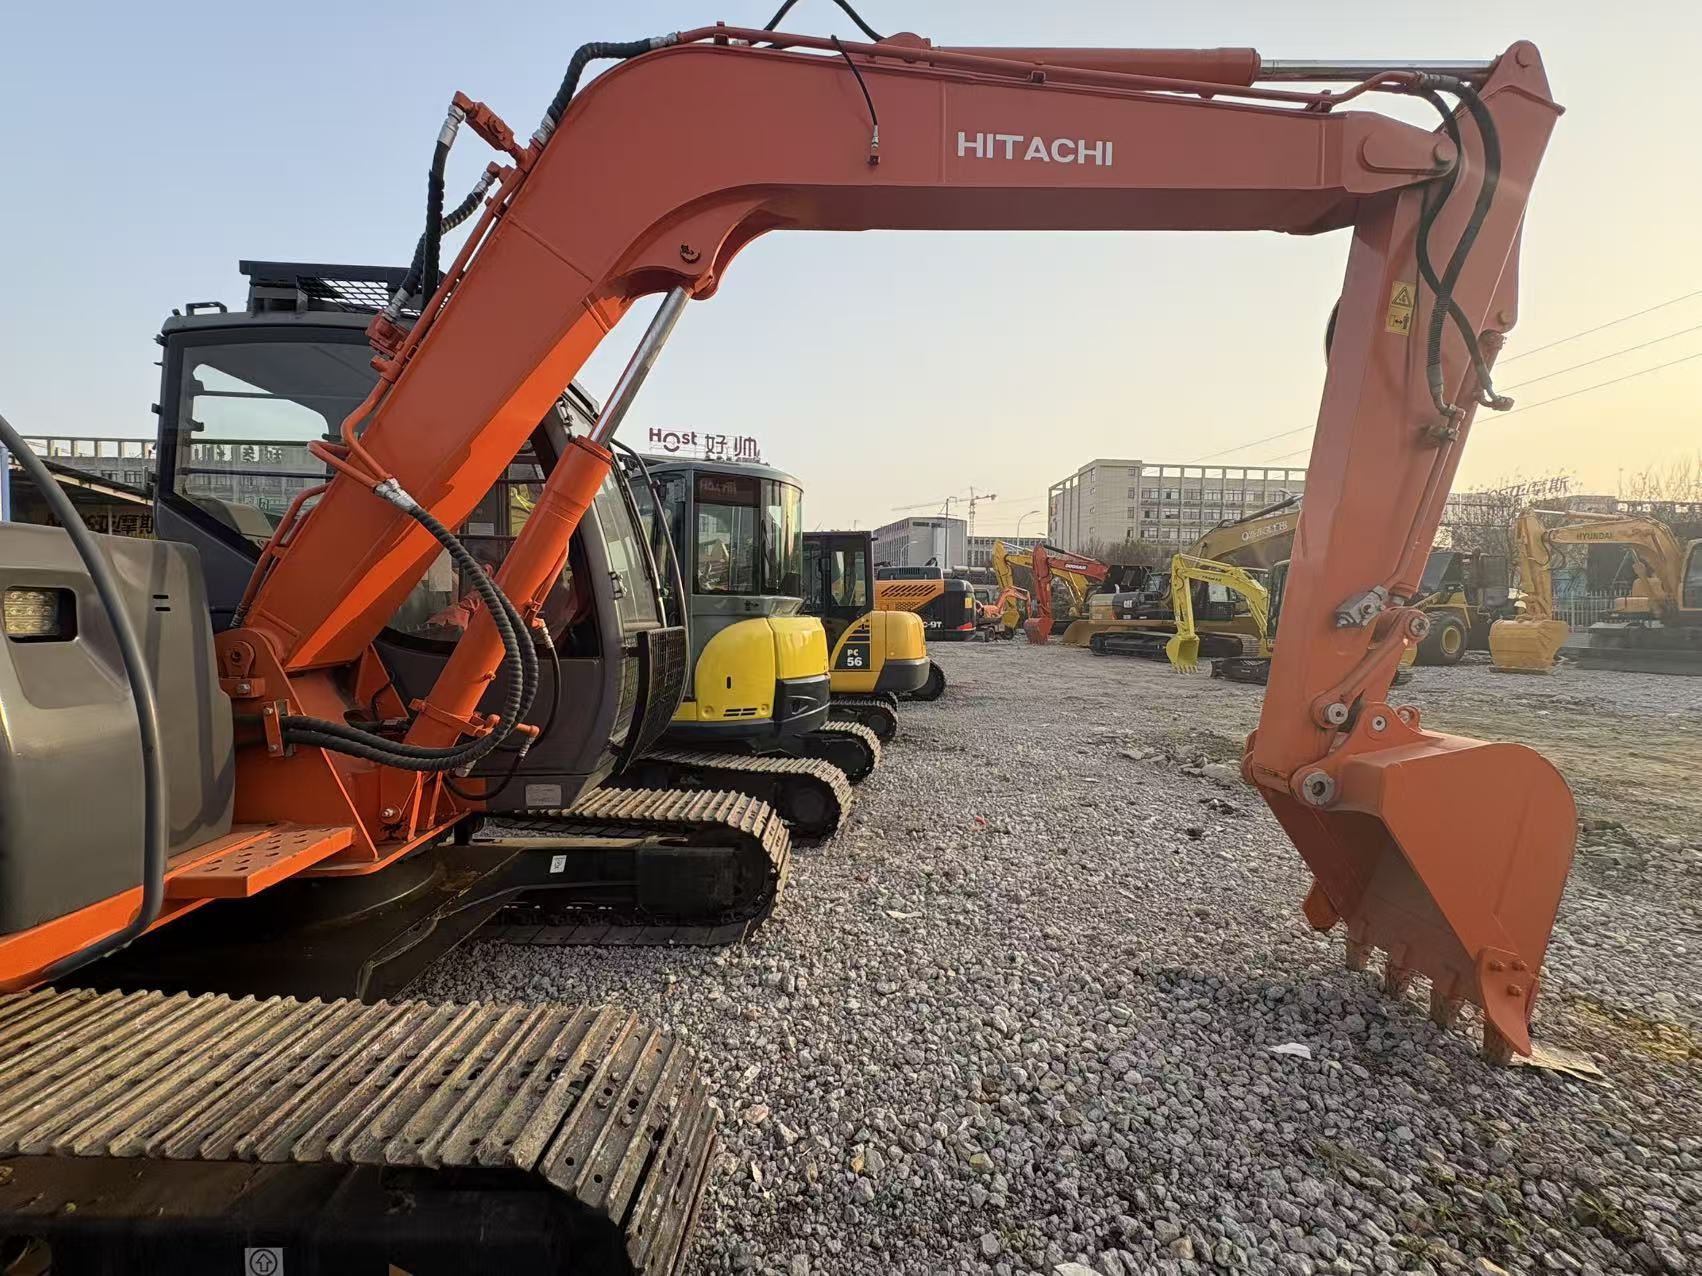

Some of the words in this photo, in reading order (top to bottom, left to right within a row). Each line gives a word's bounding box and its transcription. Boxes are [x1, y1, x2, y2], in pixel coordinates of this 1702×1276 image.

[957, 131, 1114, 167] HITACHI
[649, 428, 697, 452] Host
[1576, 532, 1612, 541] HYUNDAI
[847, 648, 859, 656] PC
[846, 657, 862, 667] 56
